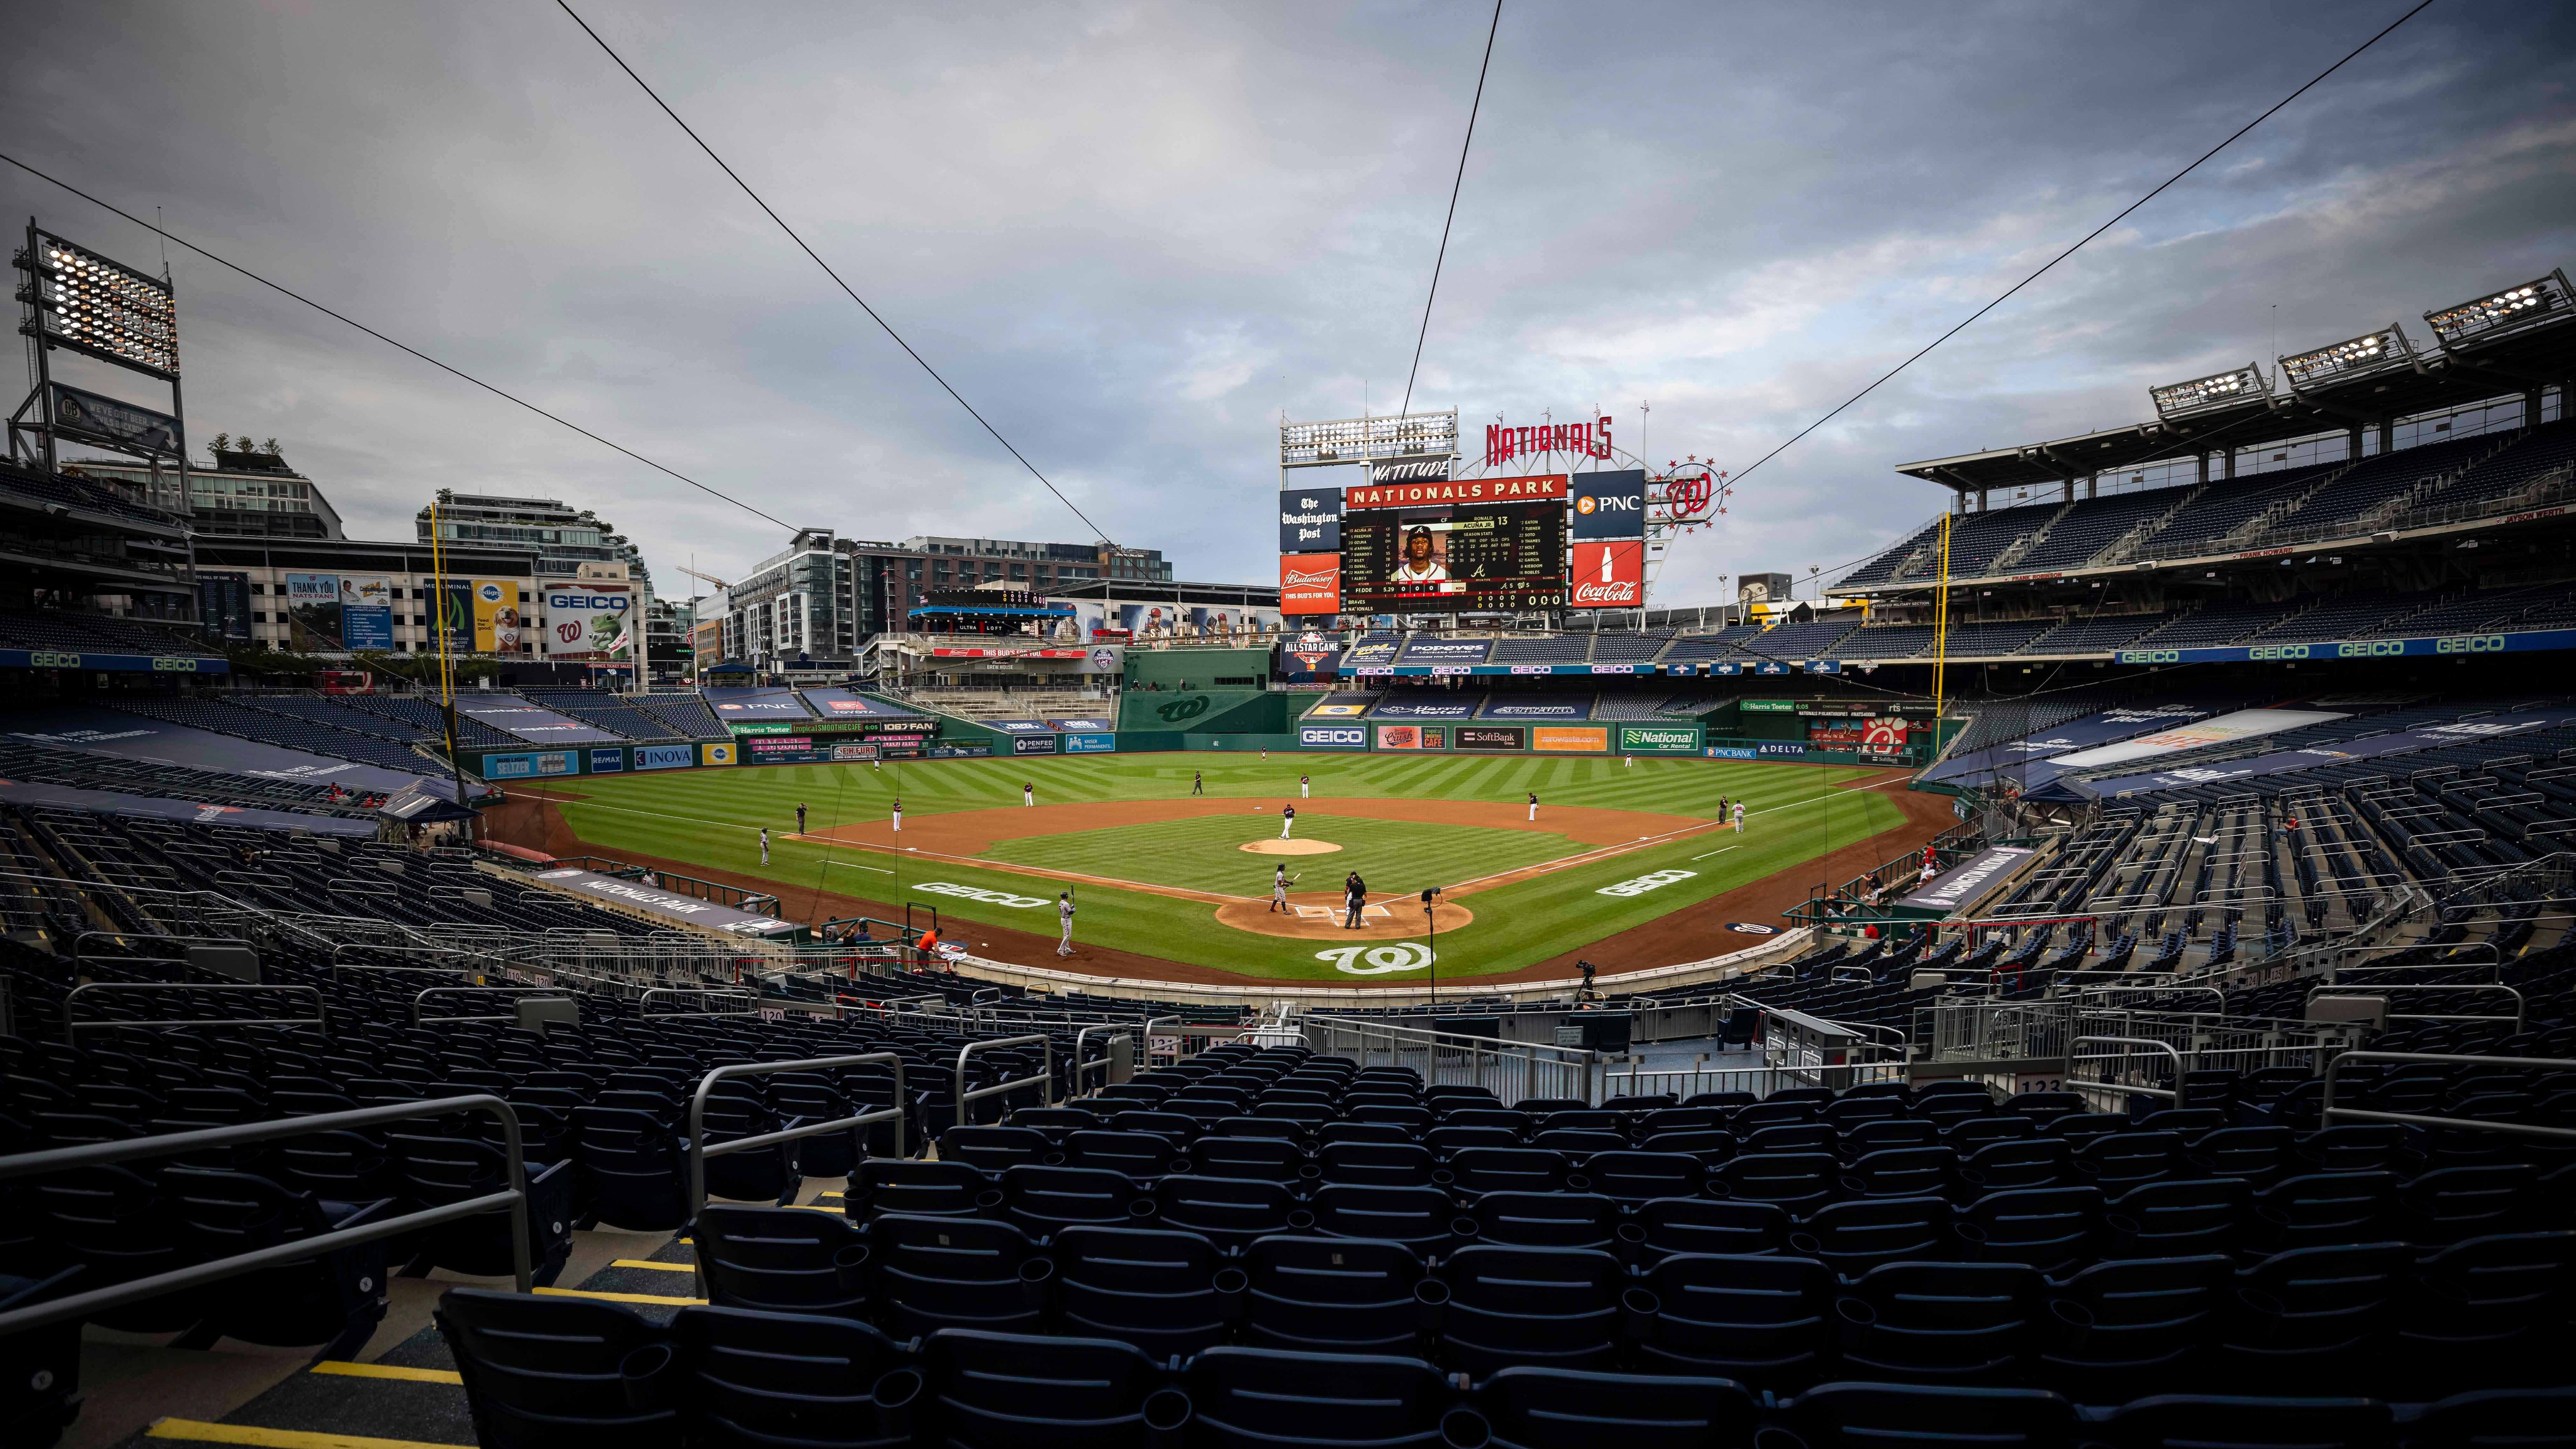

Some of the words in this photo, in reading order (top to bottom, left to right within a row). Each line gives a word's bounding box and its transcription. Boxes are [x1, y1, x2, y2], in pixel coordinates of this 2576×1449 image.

[89, 402, 113, 416] WE'VE
[114, 409, 128, 421] GOT
[116, 420, 148, 436] BACKBONE
[1486, 416, 1612, 467] NATIONALS
[1372, 460, 1449, 480] NATITUDE
[1354, 485, 1482, 503] NATIONALS
[1495, 480, 1554, 496] PARK
[1301, 497, 1319, 510] The
[1598, 496, 1640, 512] PNC
[1282, 511, 1338, 526] Washington
[1497, 516, 1508, 525] 13
[1299, 527, 1321, 541] Post
[1285, 572, 1334, 584] Budweiser
[292, 582, 317, 594] THANK
[319, 580, 334, 594] YOU
[476, 589, 506, 597] Pedigree
[1576, 581, 1638, 602] Coca-Cola
[550, 595, 628, 610] GEICO
[1285, 643, 1298, 653] ALL
[1299, 642, 1318, 652] STAR
[1319, 642, 1338, 652] GAME
[2338, 641, 2404, 657] GEICO
[2436, 635, 2505, 653] GEICO
[2122, 650, 2179, 663] GEICO
[2249, 645, 2309, 660] GEICO
[30, 652, 80, 668] GEICO
[152, 657, 197, 672] GEICO
[1356, 667, 1394, 675] GEICO
[1431, 667, 1471, 675] GEICO
[1511, 666, 1552, 674] GEICO
[1591, 665, 1634, 674] GEICO
[1889, 704, 1901, 712] rts
[793, 724, 817, 733] tropical
[1302, 730, 1363, 743] GEICO
[1385, 728, 1413, 743] Crush
[1477, 732, 1514, 741] SoftBank
[1424, 738, 1442, 747] CAFE
[1770, 745, 1804, 753] DELTA
[593, 756, 621, 764] RE/MAX
[650, 750, 691, 763] INOVA
[497, 762, 530, 775] SELTZER
[1930, 870, 1994, 898] WASHINGTON
[1971, 852, 2018, 870] NATIONALS
[1595, 869, 1698, 897] GEICO
[580, 880, 668, 902] NATIONALS
[659, 901, 711, 914] PARK
[911, 882, 1052, 908] GEICO
[1150, 1038, 1174, 1051] 121
[1770, 1041, 1782, 1049] COMPOST
[1804, 1054, 1819, 1063] RECYCLING
